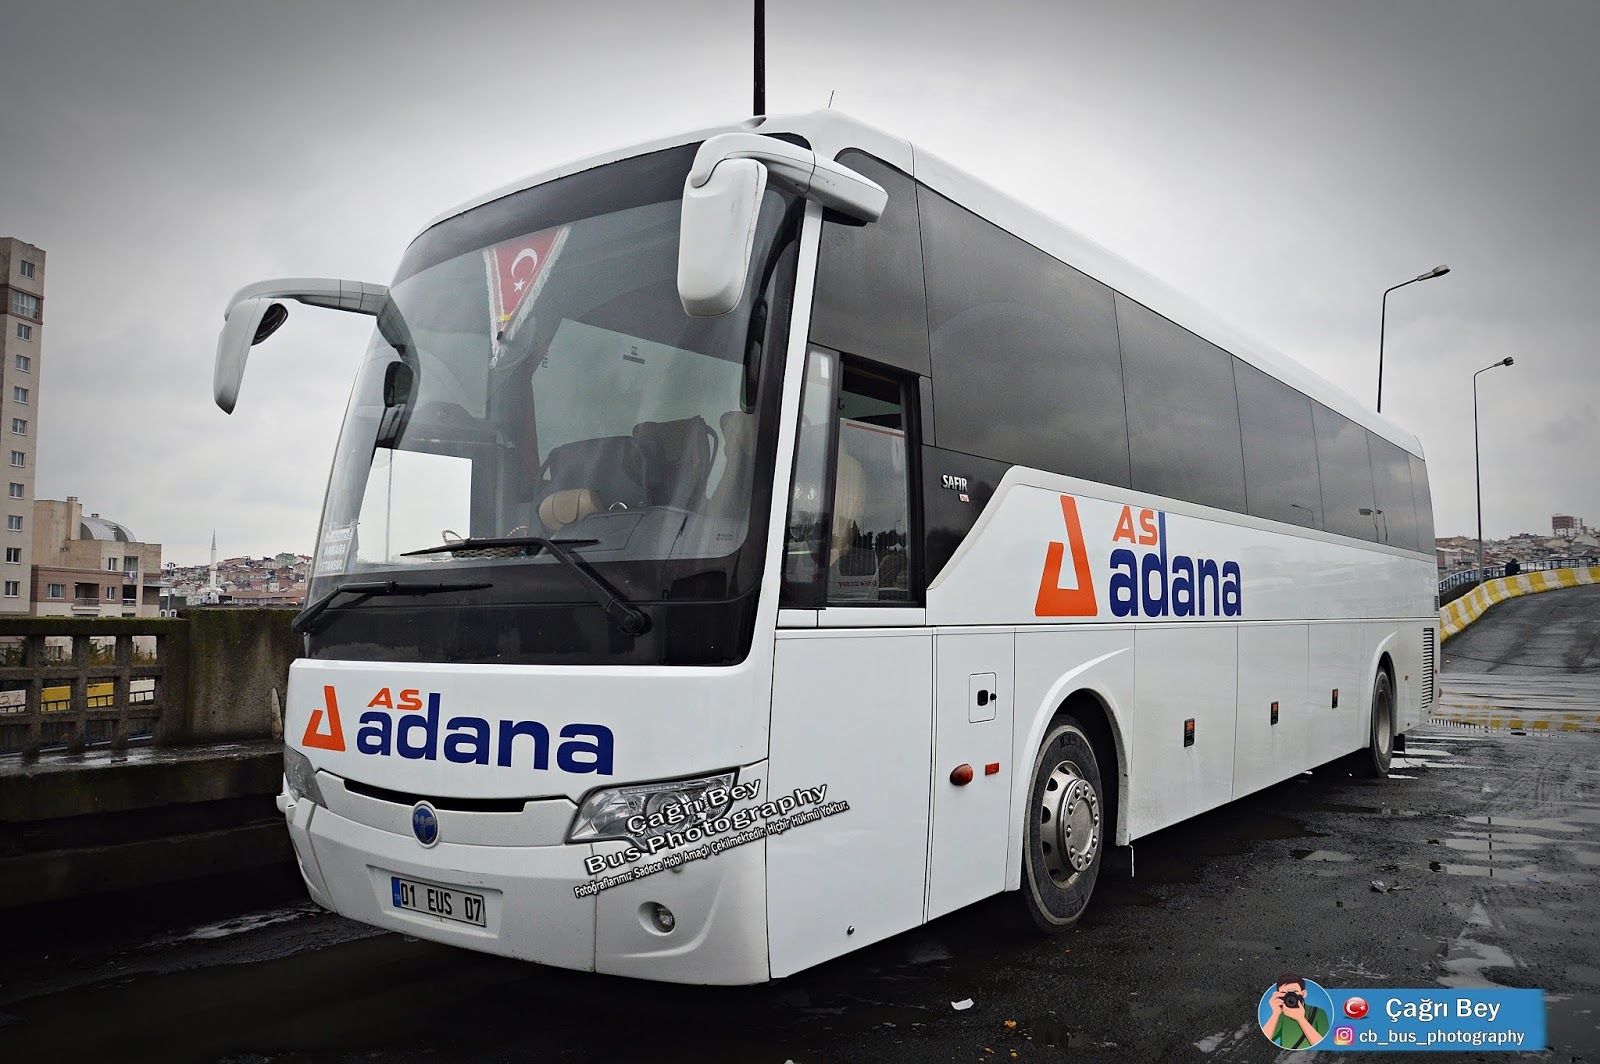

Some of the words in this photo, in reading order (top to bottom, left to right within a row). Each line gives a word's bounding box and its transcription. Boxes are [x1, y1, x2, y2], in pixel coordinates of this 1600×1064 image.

[942, 474, 968, 491] SAFIR
[1112, 505, 1158, 546] AS
[1109, 511, 1242, 617] adana
[367, 687, 423, 711] AS
[356, 692, 614, 776] adana
[400, 882, 417, 907] 01
[427, 888, 453, 915] EUS
[464, 896, 482, 921] 07
